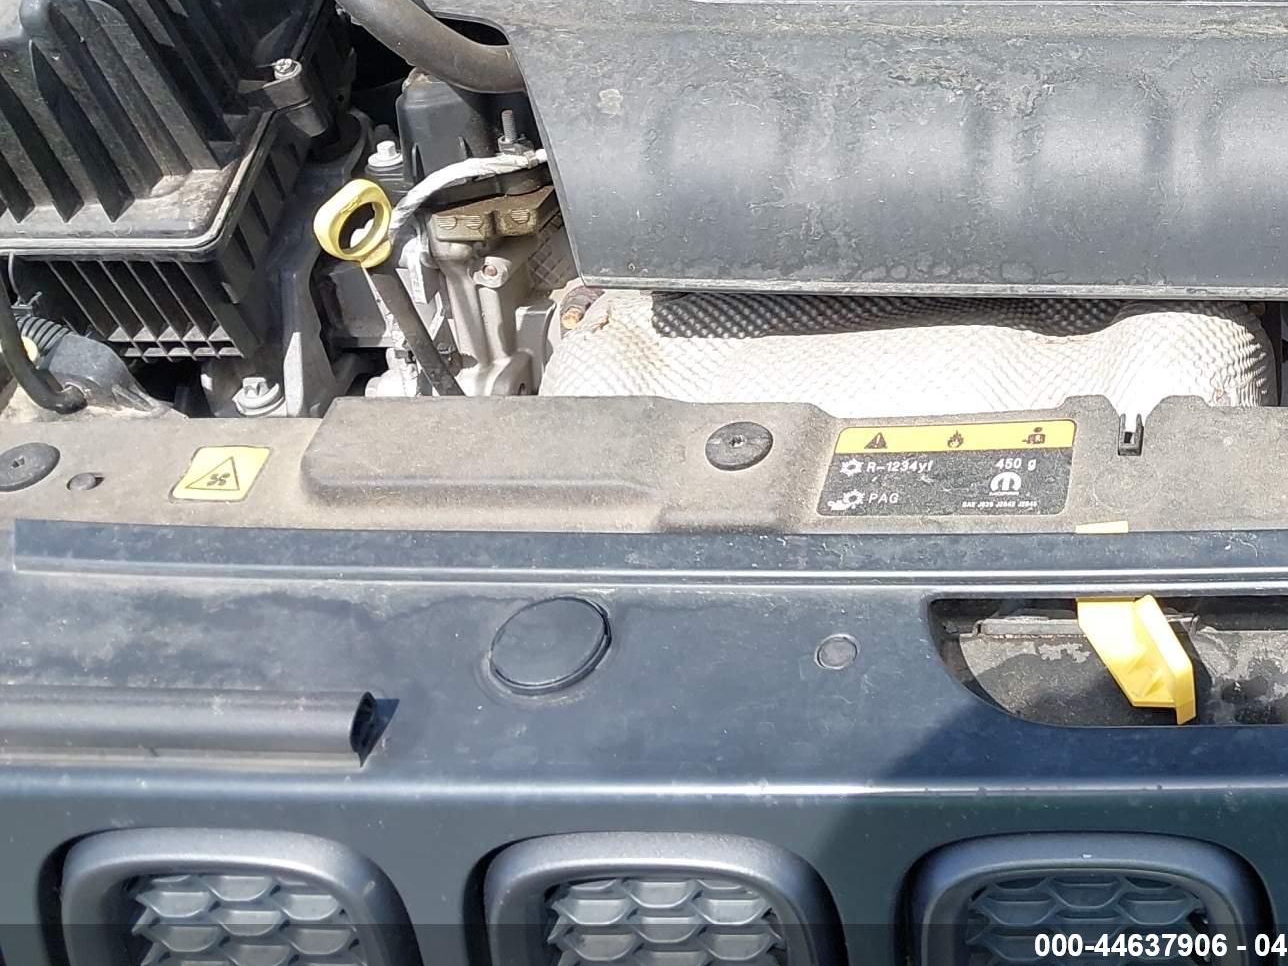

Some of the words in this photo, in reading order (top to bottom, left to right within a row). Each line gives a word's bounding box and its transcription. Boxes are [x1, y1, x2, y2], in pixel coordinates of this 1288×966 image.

[866, 460, 934, 473] R-1234yf
[995, 457, 1022, 470] 450
[1028, 458, 1037, 471] g
[868, 493, 900, 504] PAG
